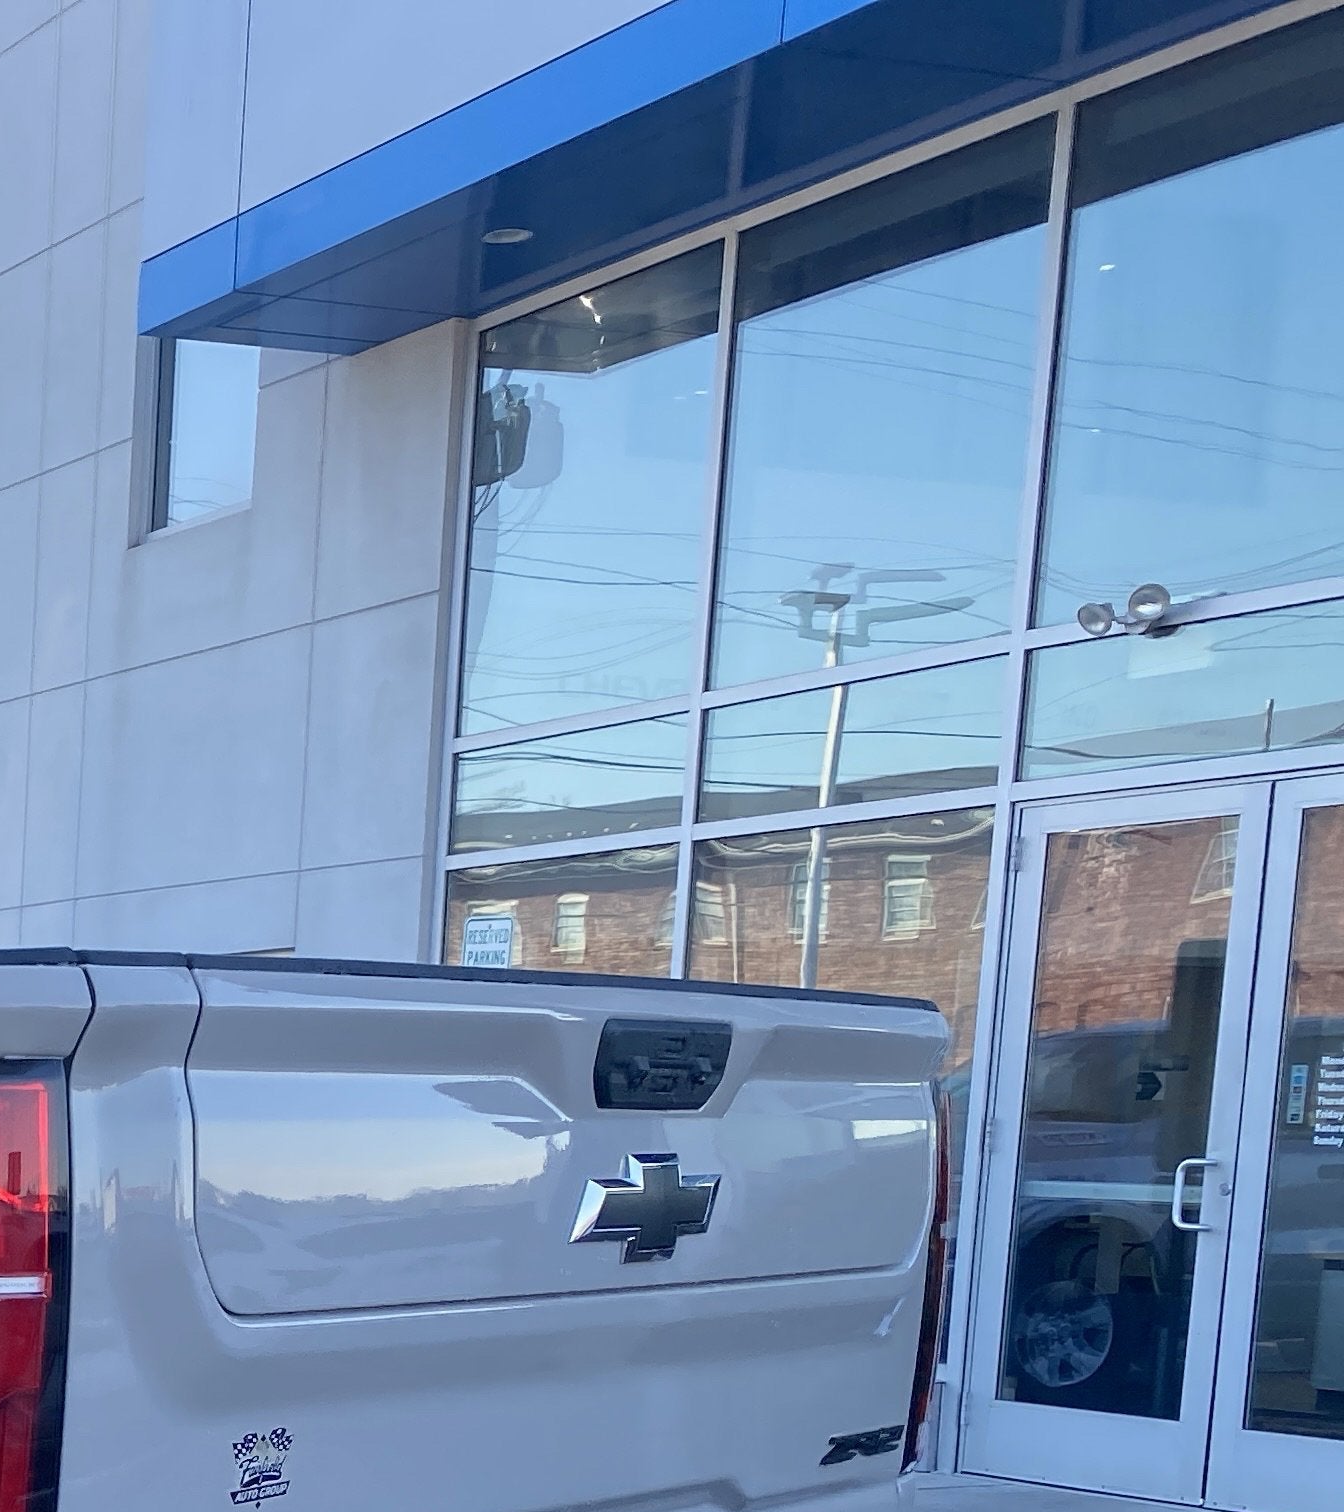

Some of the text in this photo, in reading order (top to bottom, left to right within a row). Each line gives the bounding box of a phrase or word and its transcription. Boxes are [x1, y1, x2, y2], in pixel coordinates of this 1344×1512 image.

[468, 928, 510, 944] RESERVED
[467, 950, 506, 966] PARKING
[234, 1483, 289, 1503] AUTO GROUP
